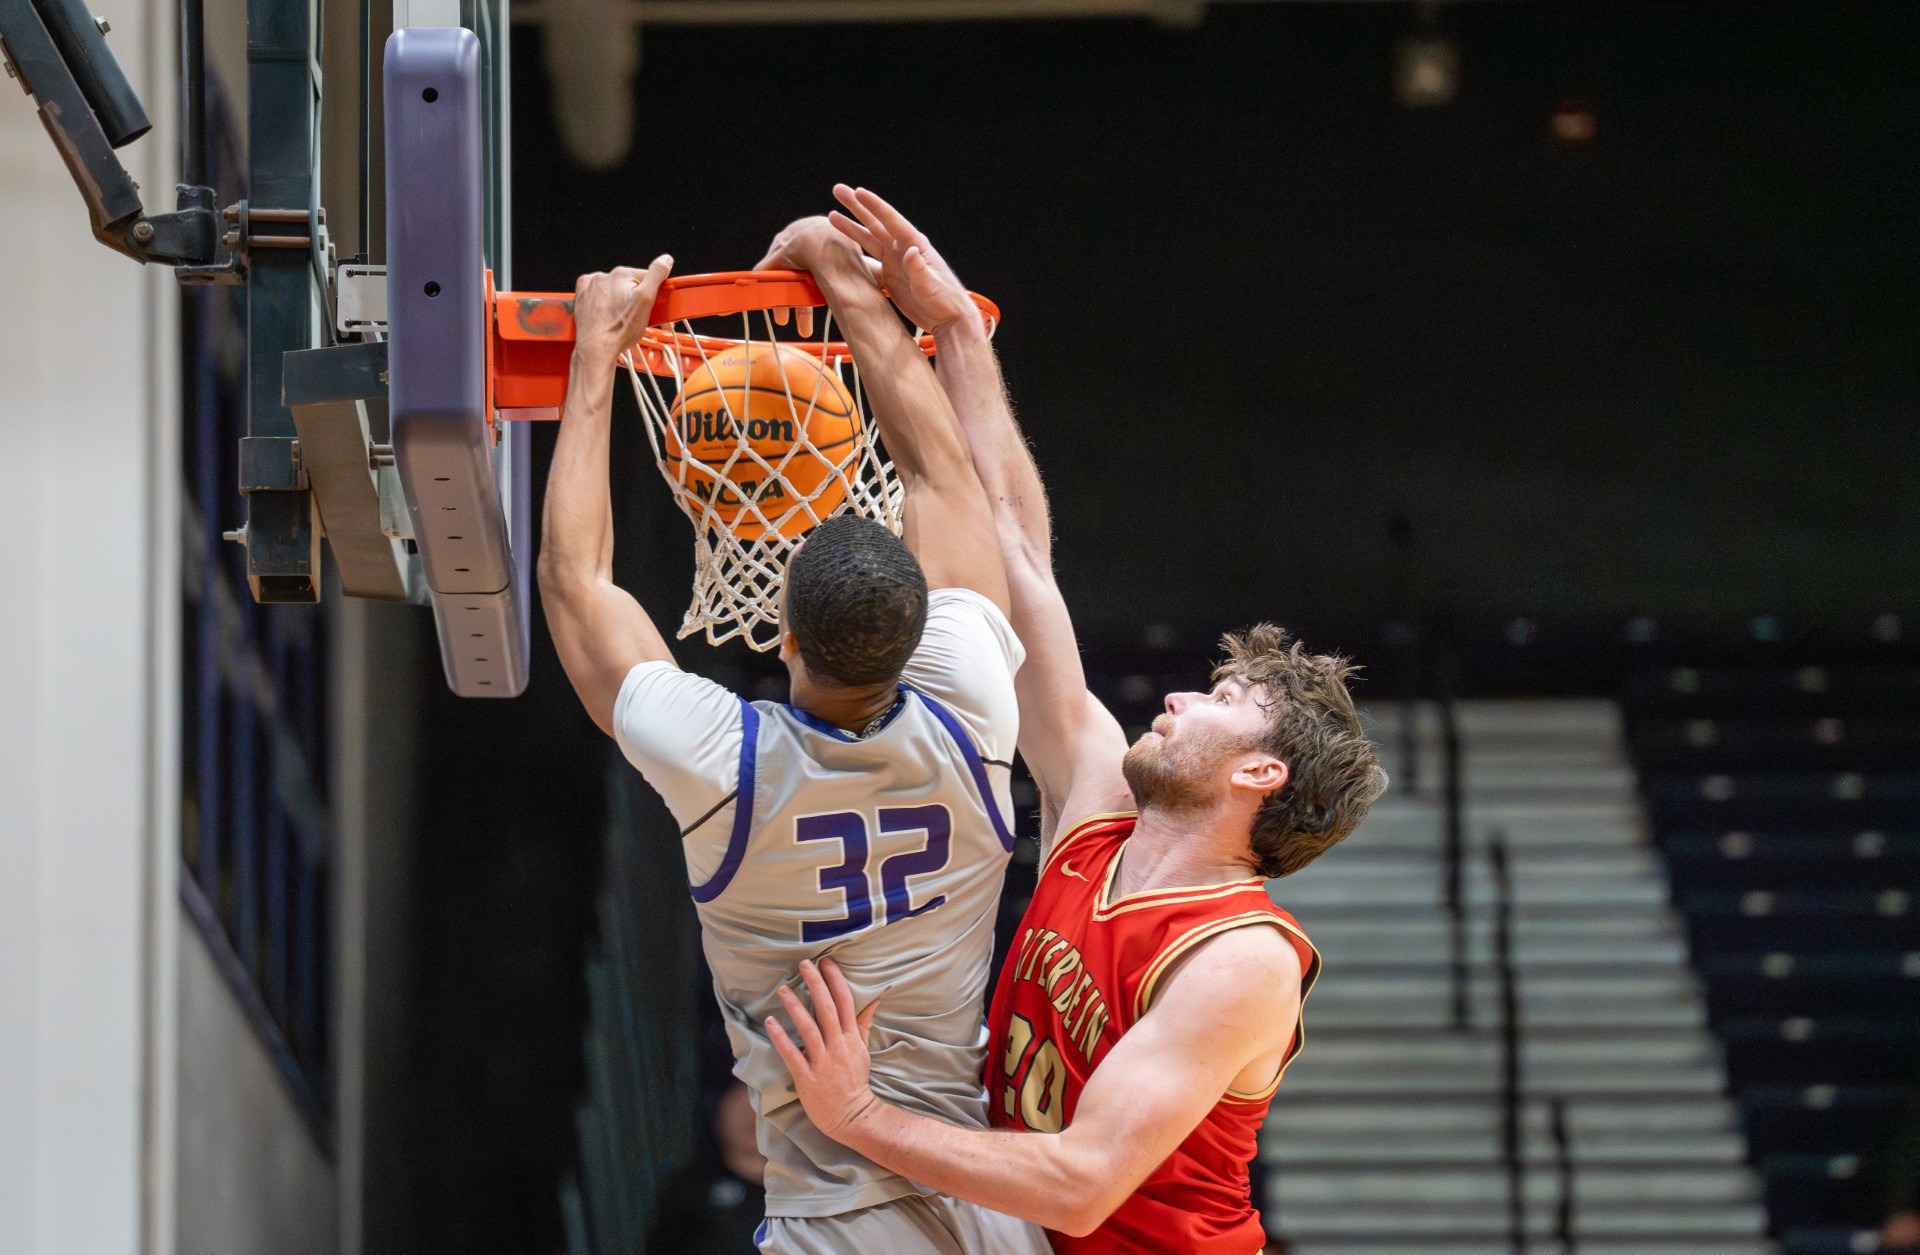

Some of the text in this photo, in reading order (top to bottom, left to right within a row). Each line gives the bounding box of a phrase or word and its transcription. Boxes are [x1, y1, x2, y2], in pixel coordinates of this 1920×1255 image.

[677, 407, 795, 445] Wilson
[695, 477, 785, 505] NCAA
[793, 803, 954, 943] 32
